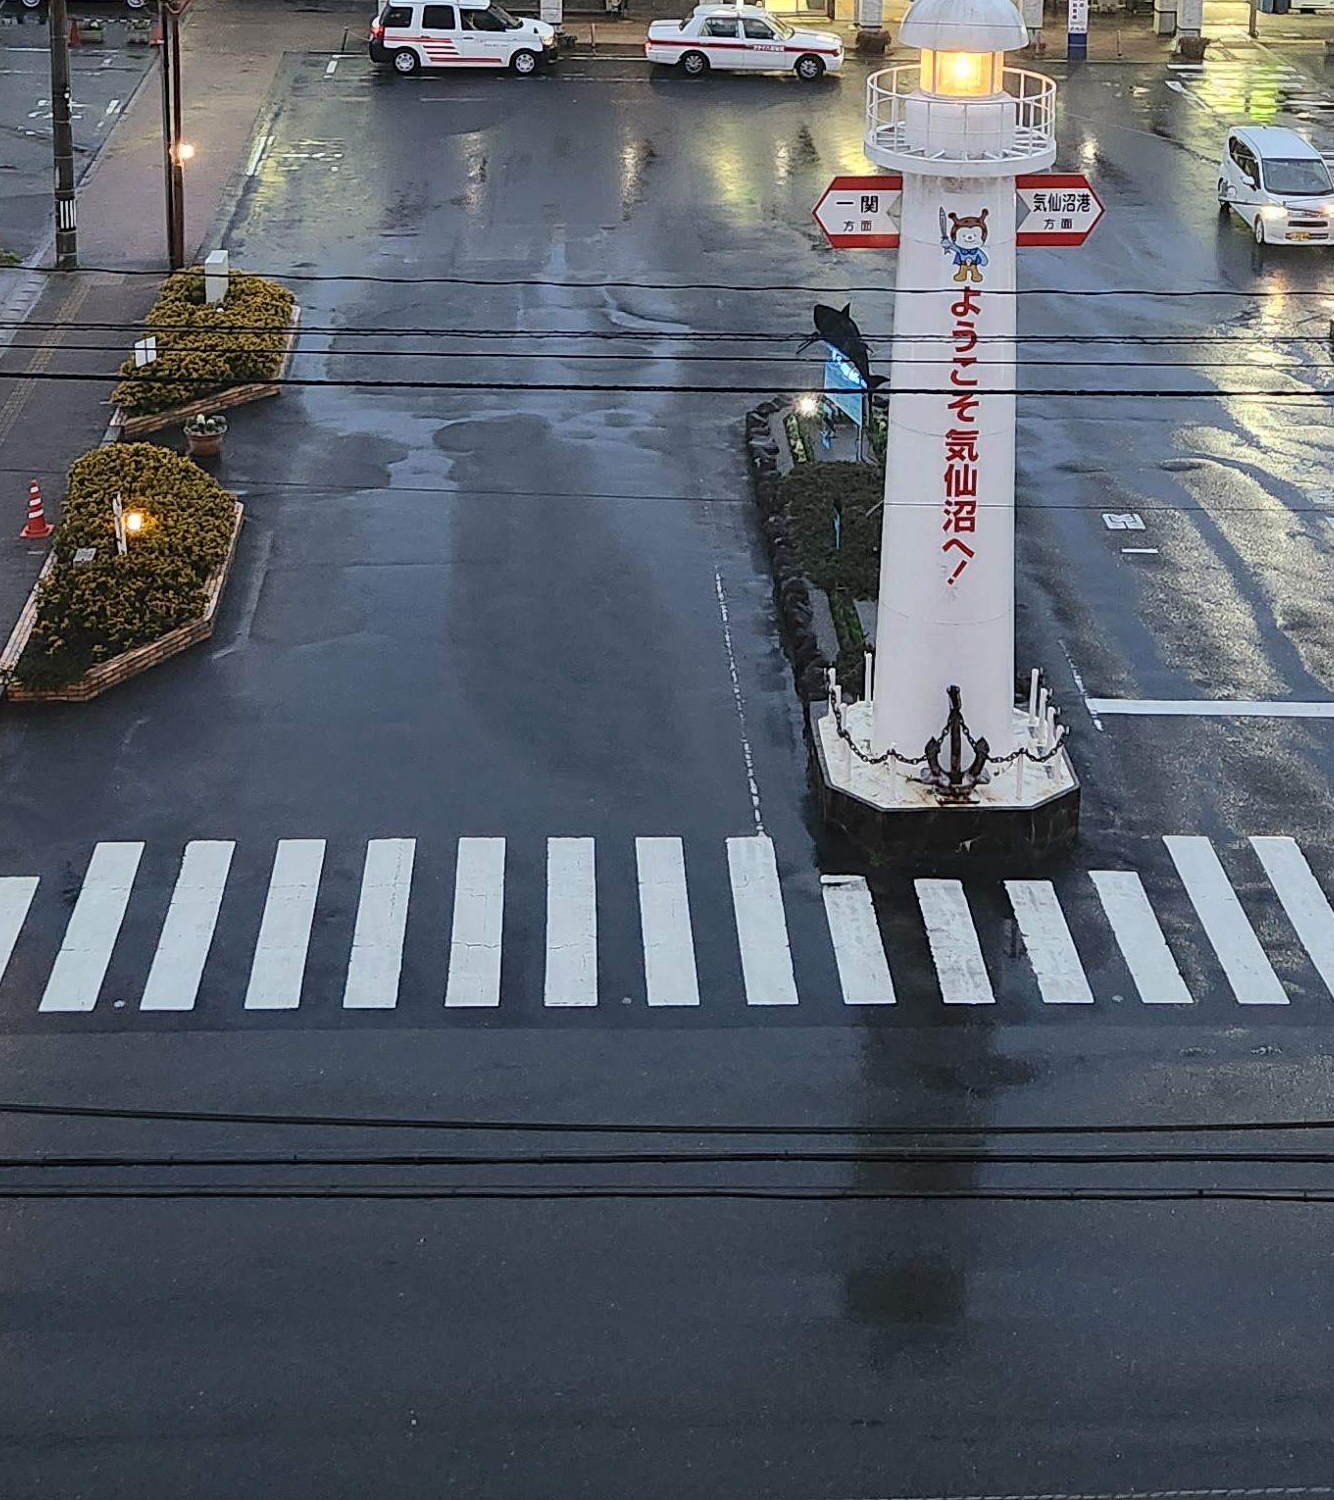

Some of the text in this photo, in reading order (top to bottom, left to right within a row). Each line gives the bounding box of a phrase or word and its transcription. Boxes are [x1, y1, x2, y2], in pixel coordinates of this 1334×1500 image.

[836, 195, 879, 214] 一関
[1033, 193, 1091, 213] 気仙沼港
[843, 220, 872, 232] 方面
[1043, 218, 1072, 230] 方面
